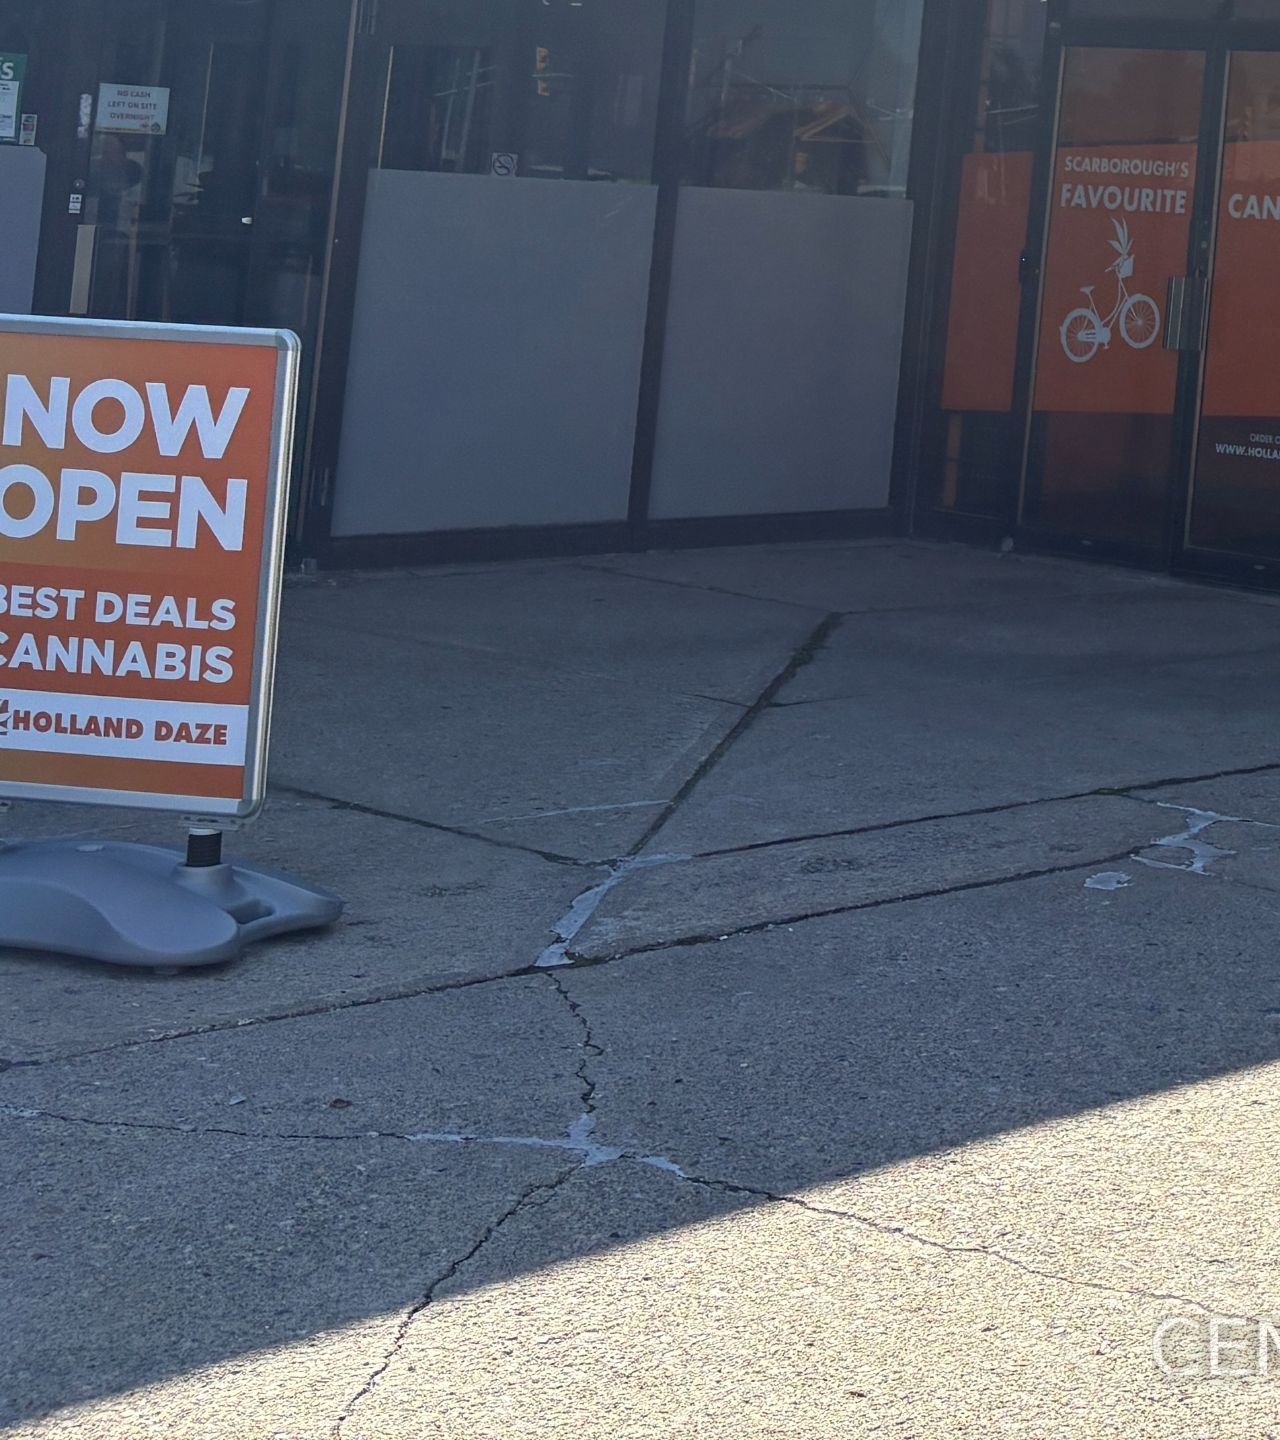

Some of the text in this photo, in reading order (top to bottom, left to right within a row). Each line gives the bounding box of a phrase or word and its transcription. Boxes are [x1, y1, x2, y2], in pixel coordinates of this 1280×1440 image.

[1064, 155, 1190, 179] SCARBOROUGH'S
[1059, 183, 1188, 215] FAVOURITE
[2, 374, 250, 460] NOW
[0, 464, 247, 552] OPEN
[95, 591, 236, 632] DEALS
[12, 709, 227, 746] HOLLAND DAZE
